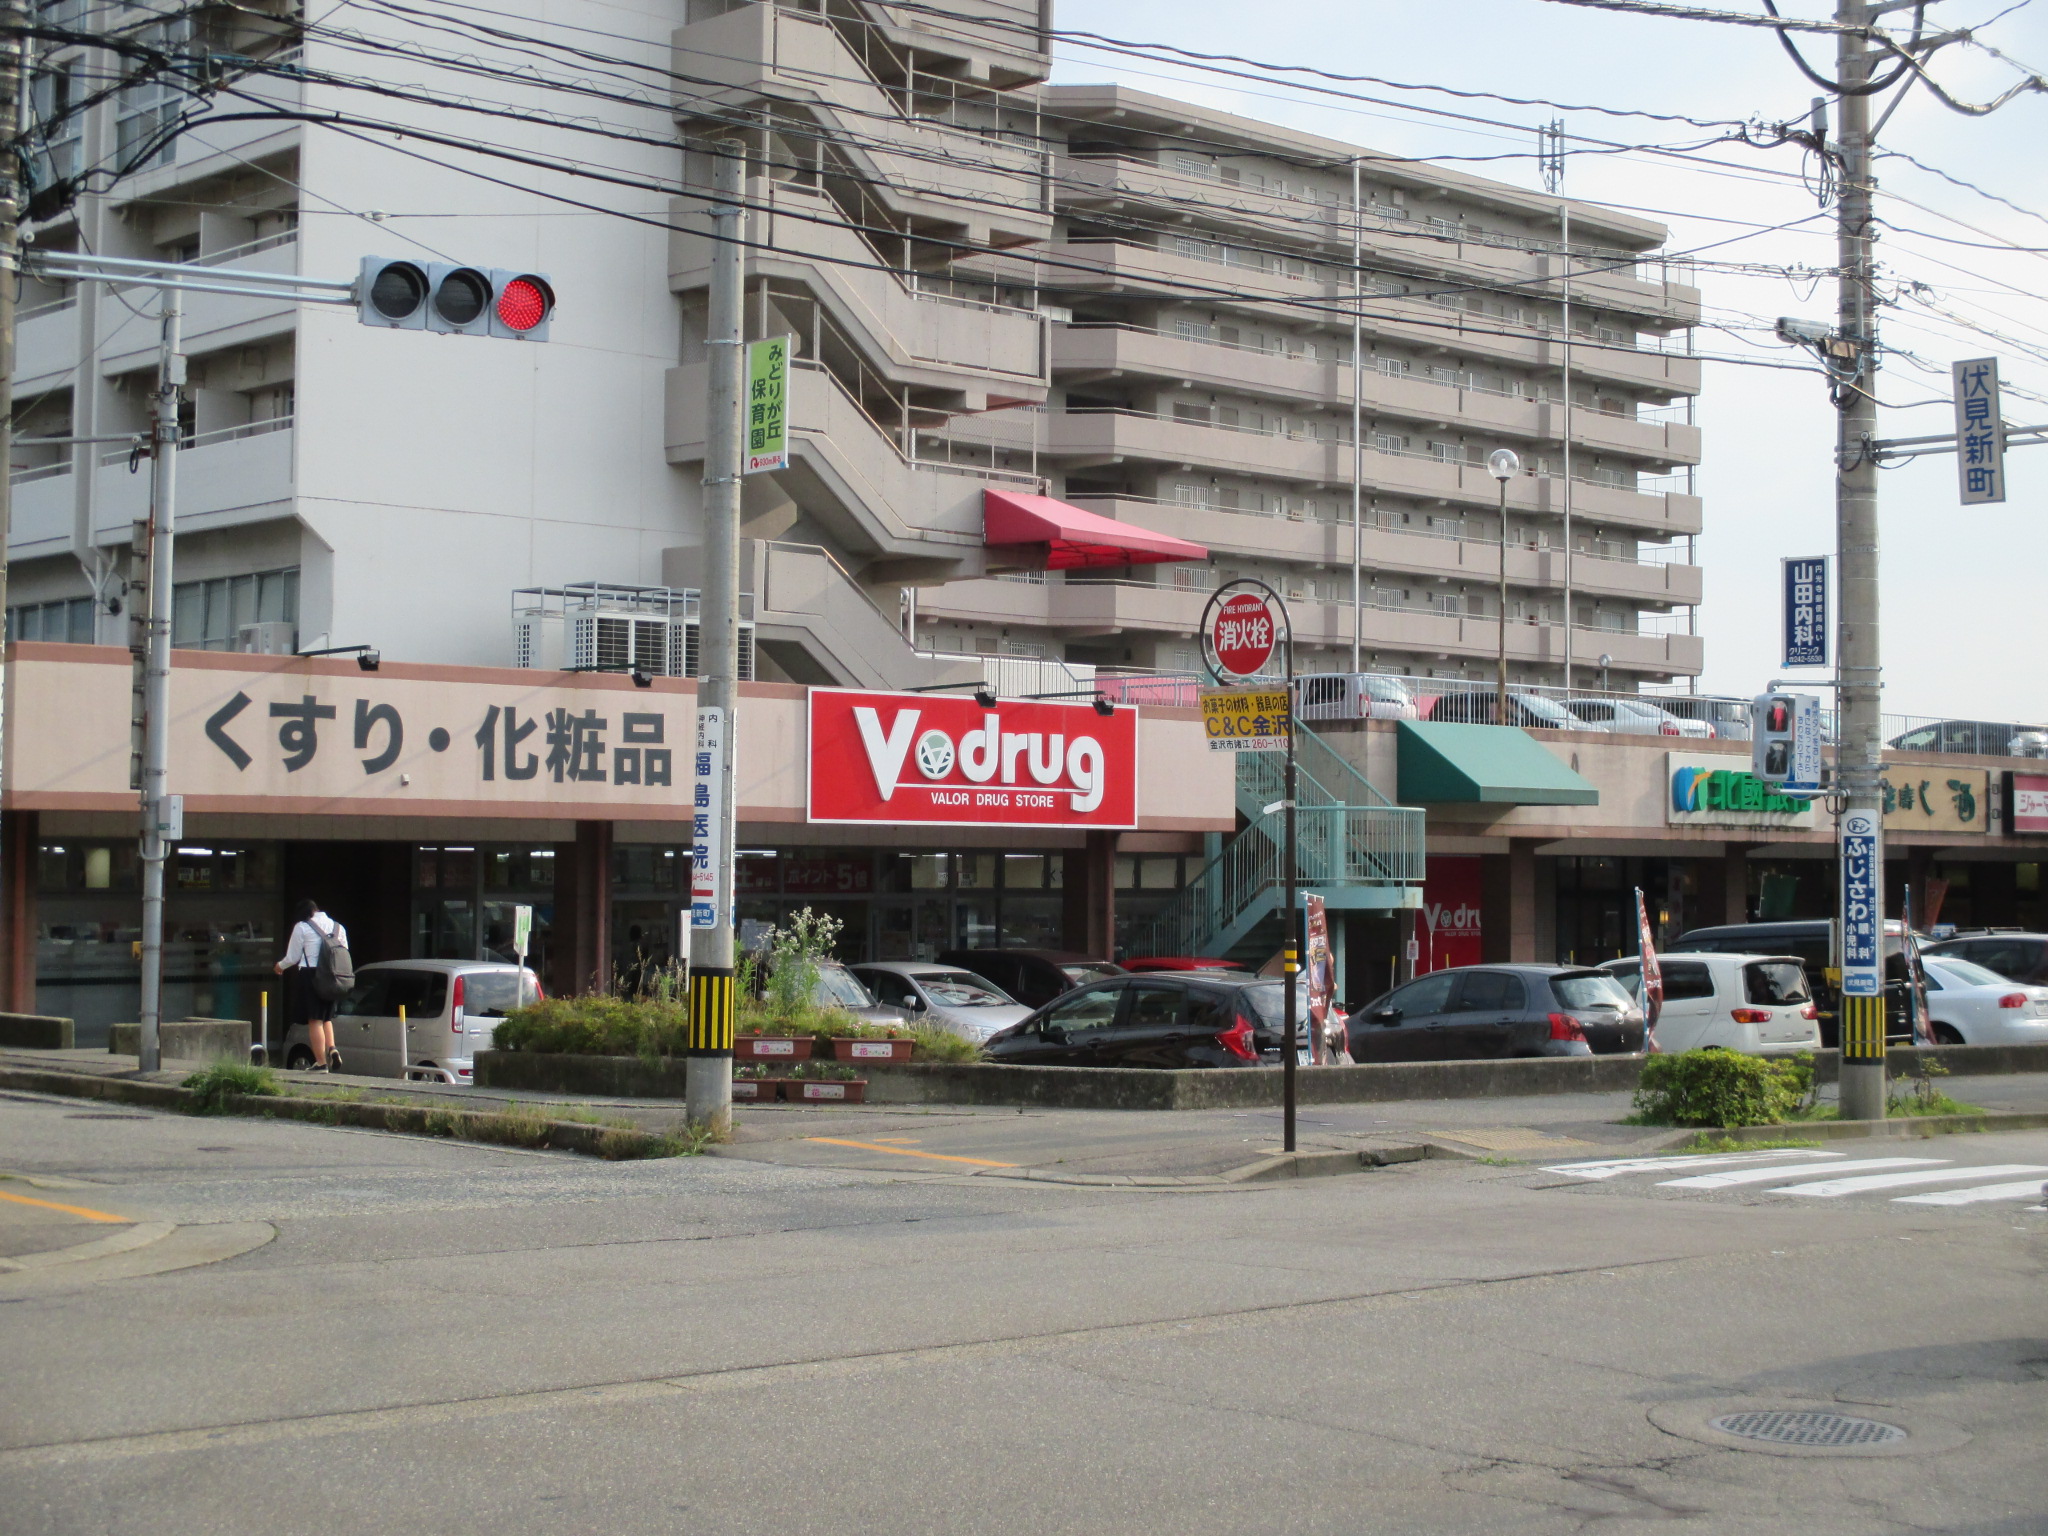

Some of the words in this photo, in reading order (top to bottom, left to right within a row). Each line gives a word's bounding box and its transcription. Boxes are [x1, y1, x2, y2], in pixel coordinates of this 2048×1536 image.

[768, 345, 783, 439] みどりが丘
[751, 378, 766, 450] 保育園
[1961, 364, 1995, 497] 伏見新町
[1223, 605, 1236, 614] FIRE
[1237, 603, 1263, 613] HYDRANT
[1794, 563, 1813, 646] 山田内科
[1219, 617, 1269, 651] 消火栓
[1789, 646, 1819, 656] クリニック
[205, 690, 671, 786] くすり・化粧品
[1252, 738, 1289, 749] 260-110
[931, 792, 969, 805] VALOR
[976, 793, 1009, 807] DRUG
[1016, 795, 1053, 807] STORE
[1848, 838, 1868, 921] ふじさわ
[1847, 923, 1857, 959] 小児科
[1858, 922, 1869, 959] 眼科
